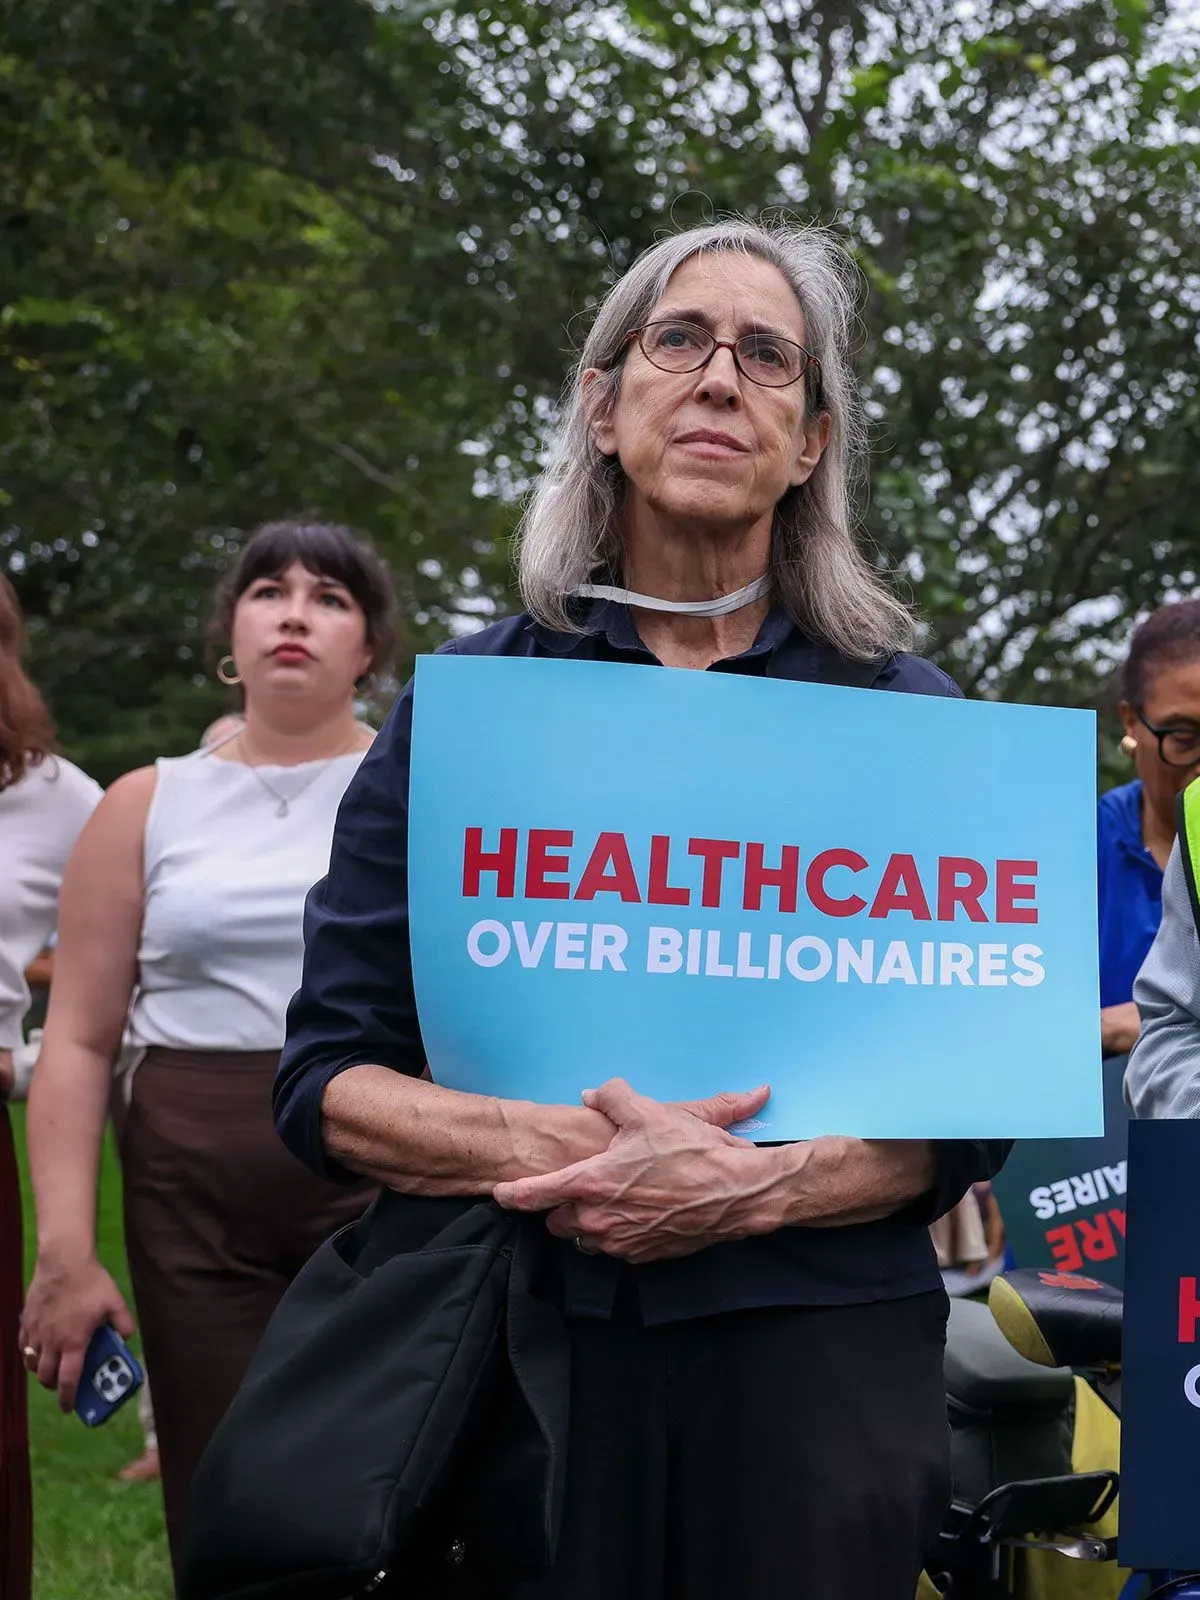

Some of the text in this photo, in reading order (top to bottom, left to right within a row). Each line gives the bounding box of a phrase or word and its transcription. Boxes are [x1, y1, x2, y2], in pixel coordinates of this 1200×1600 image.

[462, 826, 1039, 924] HEALTHCARE
[466, 919, 1046, 987] OVER BILLIONAIRES
